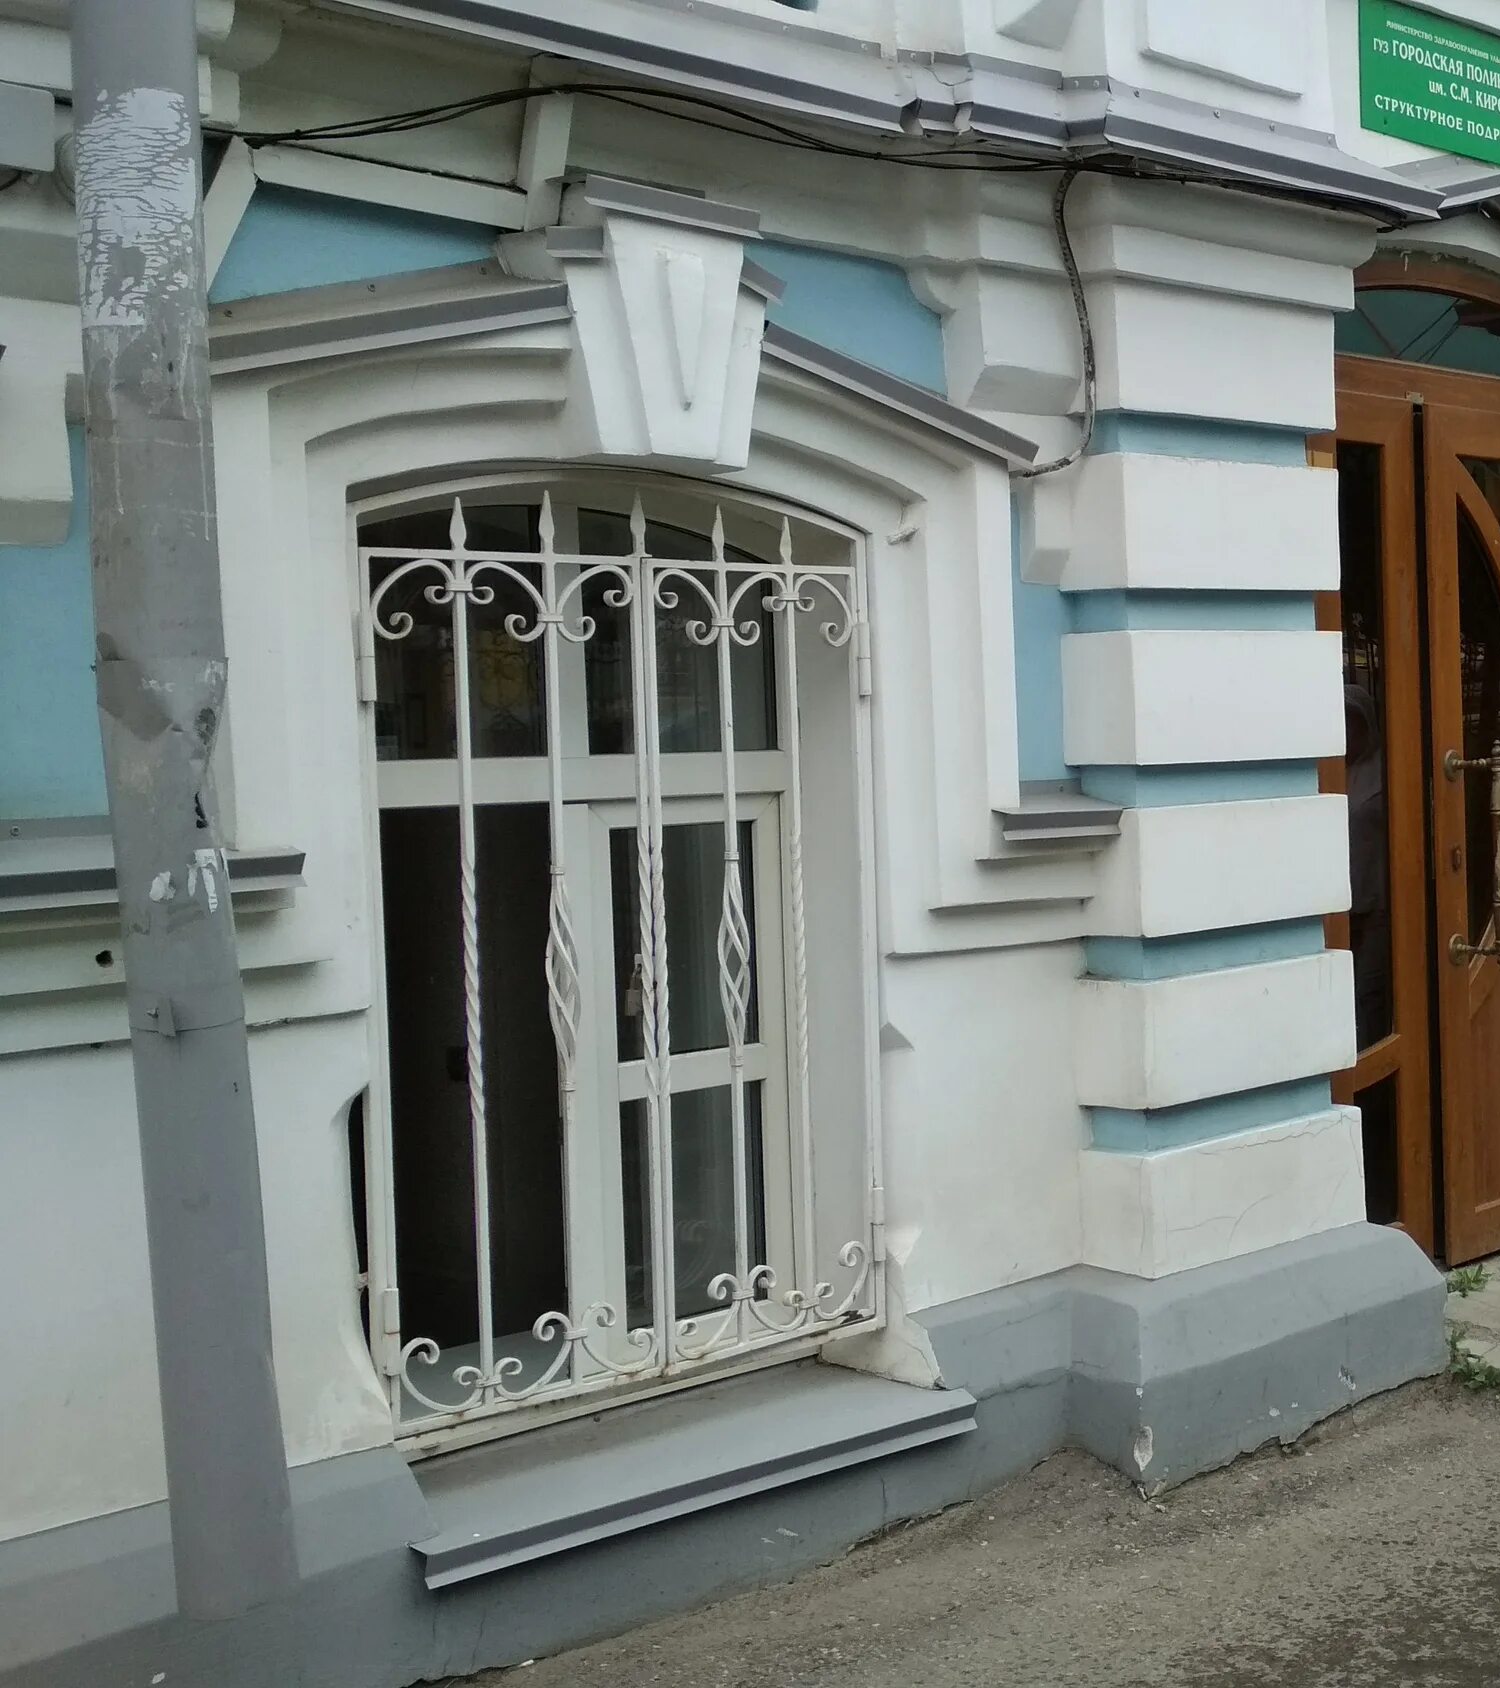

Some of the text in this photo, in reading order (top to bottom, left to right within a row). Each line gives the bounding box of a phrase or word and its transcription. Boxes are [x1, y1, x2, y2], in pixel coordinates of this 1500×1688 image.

[1386, 20, 1433, 41] МИНИСТЕРСТВО
[1373, 37, 1389, 54] ГУЗ
[1392, 39, 1463, 77] ГОРОДСКАЯ
[1449, 82, 1473, 105] С.М.
[1374, 94, 1464, 131] СТРУКТУРНОЕ
